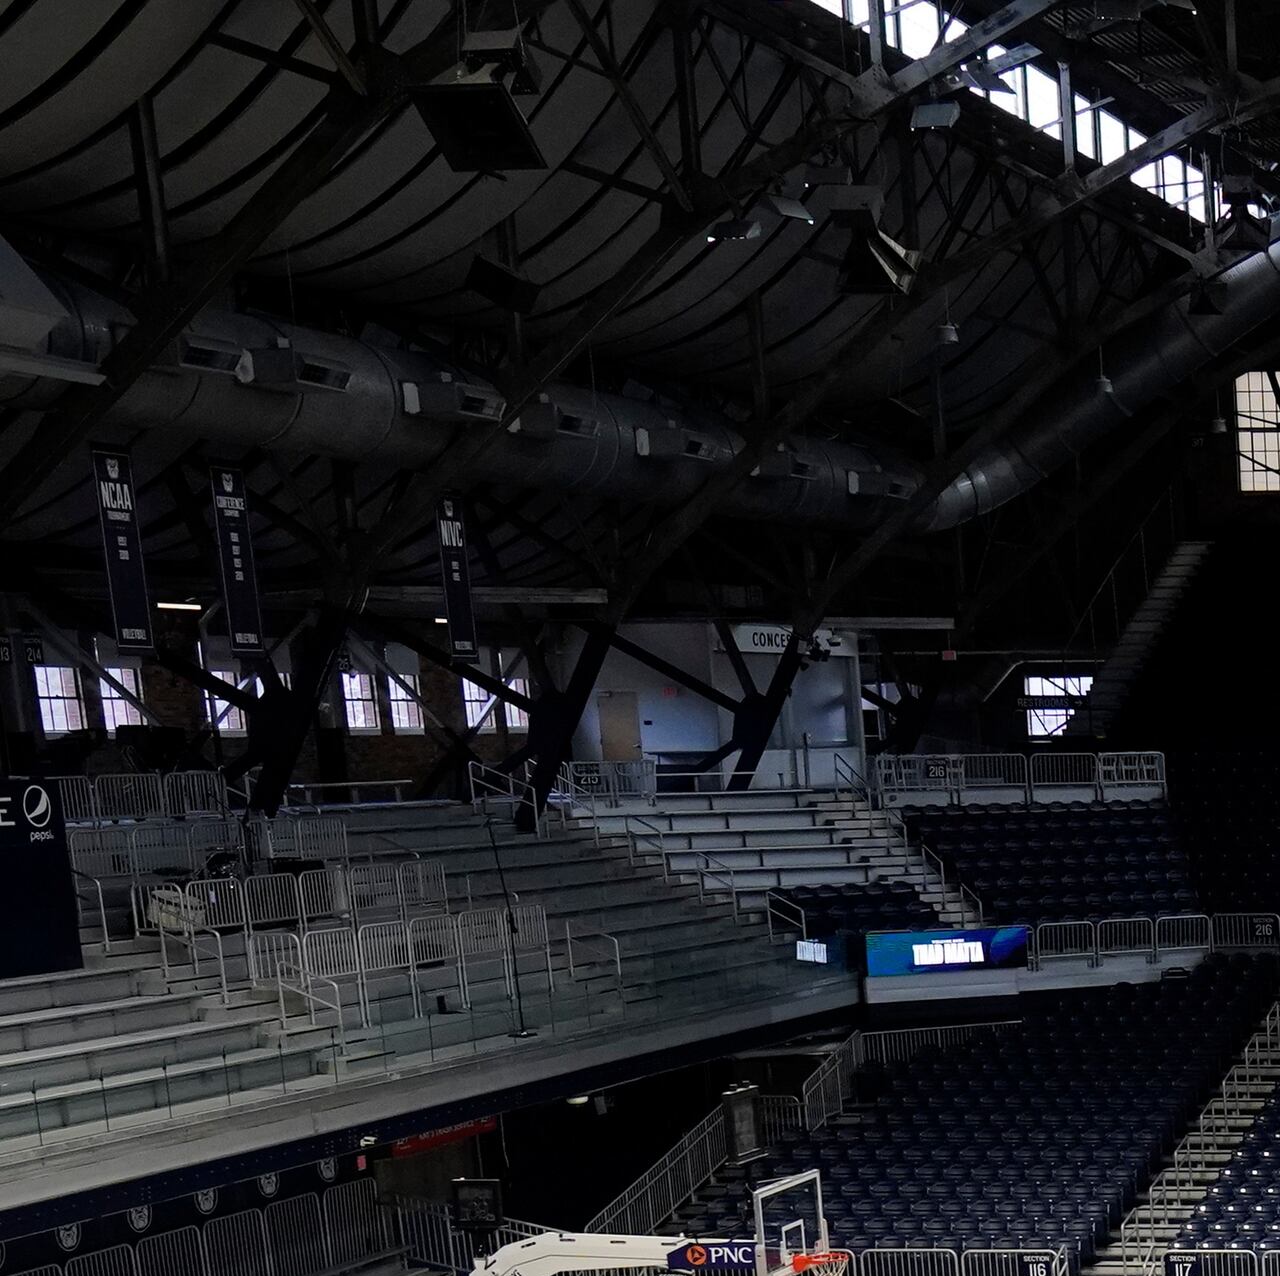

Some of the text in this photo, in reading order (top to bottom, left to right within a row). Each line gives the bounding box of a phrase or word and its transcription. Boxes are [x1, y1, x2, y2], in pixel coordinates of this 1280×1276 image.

[100, 481, 132, 511] NCAA
[440, 520, 463, 547] NIVC
[1016, 698, 1070, 709] RESTROOMS
[929, 766, 945, 777] 216
[1255, 924, 1273, 935] 216
[710, 1246, 753, 1264] PNC
